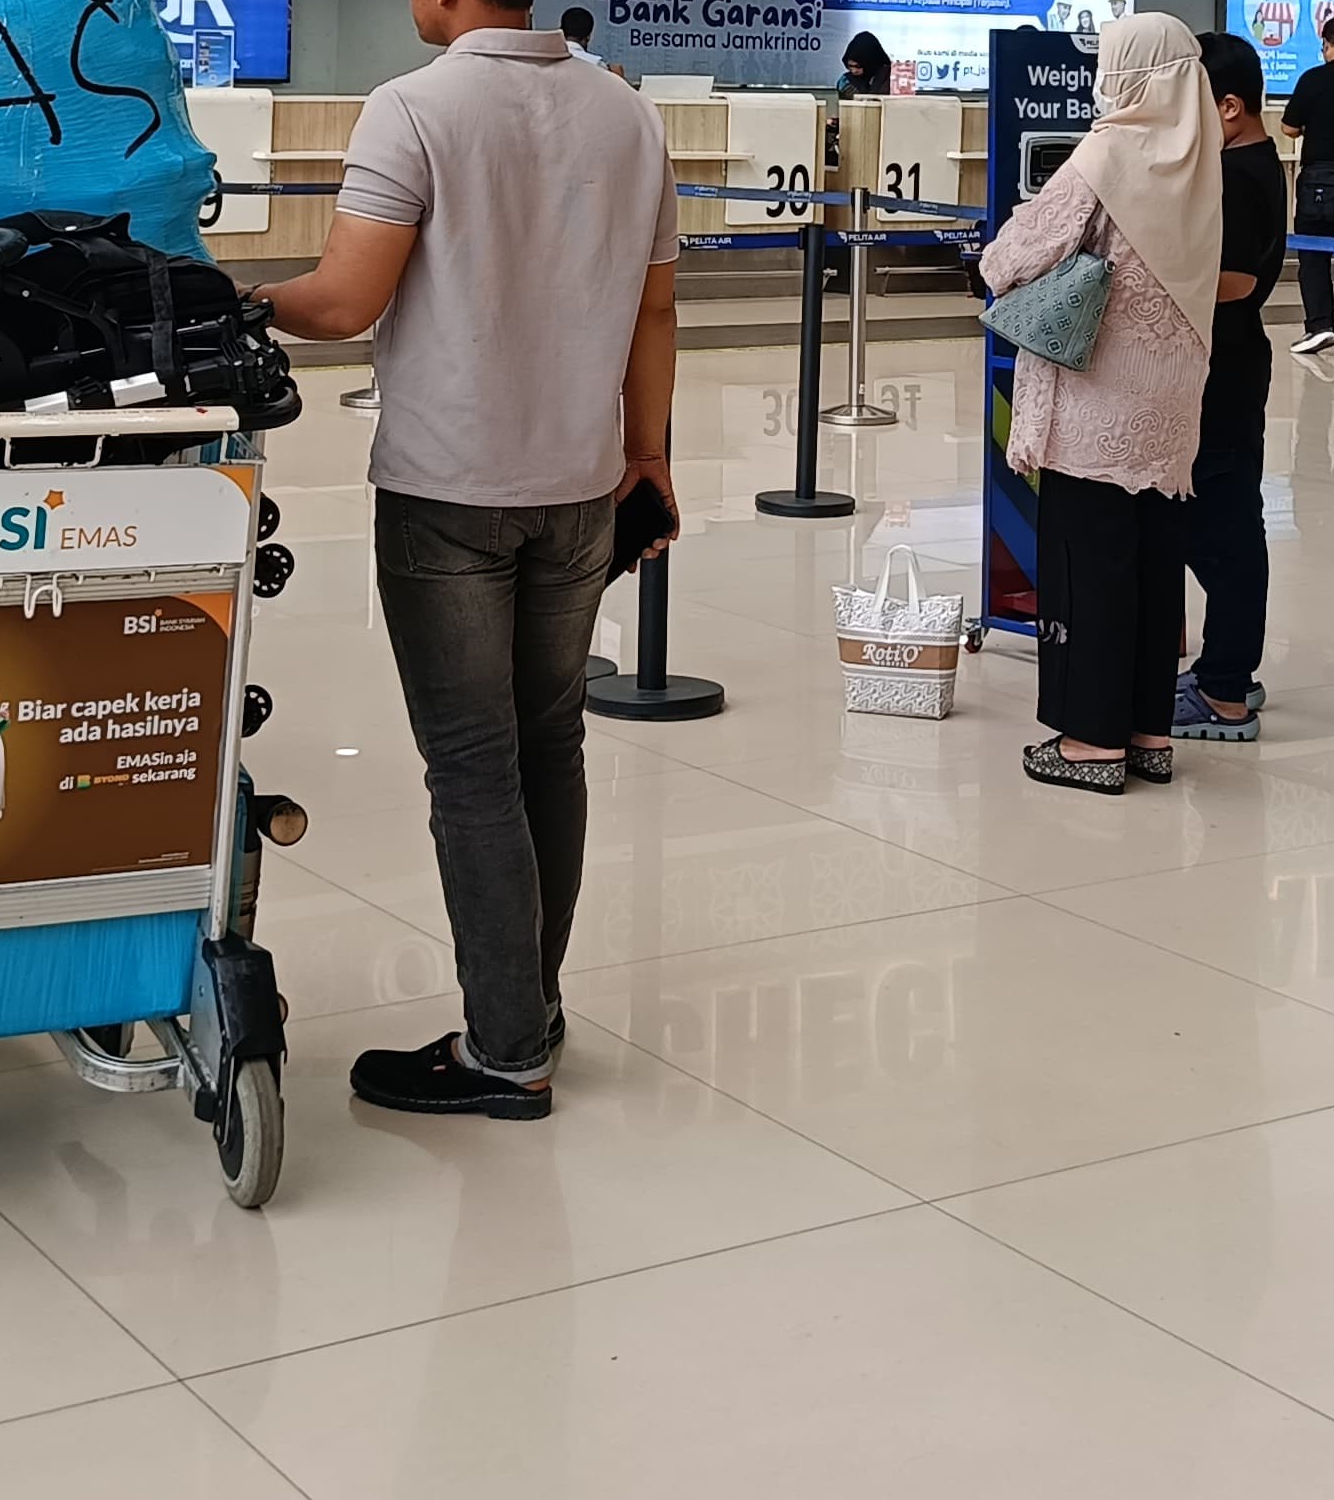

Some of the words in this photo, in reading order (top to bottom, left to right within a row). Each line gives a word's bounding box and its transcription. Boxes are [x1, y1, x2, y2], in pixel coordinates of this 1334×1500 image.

[630, 29, 716, 49] Bersama
[721, 32, 821, 51] Jamkrindo
[1027, 64, 1092, 92] Weigh
[1015, 98, 1061, 119] Your
[766, 163, 811, 218] 30
[885, 162, 921, 215] 31
[689, 237, 717, 246] PELITA
[717, 236, 732, 245] AIR
[848, 234, 872, 243] PELITA
[871, 233, 887, 241] AIR
[944, 231, 967, 240] PELITA
[967, 231, 981, 239] AIR
[60, 526, 138, 549] EMAS
[123, 615, 157, 635] BSI
[17, 700, 67, 722] Biar
[71, 692, 139, 720] capek
[145, 687, 201, 712] kerja
[59, 721, 101, 743] ada
[106, 715, 199, 739] hasilnya
[116, 751, 173, 770] EMASin
[175, 749, 197, 764] aja
[59, 776, 74, 791] di
[132, 766, 196, 784] sekarang
